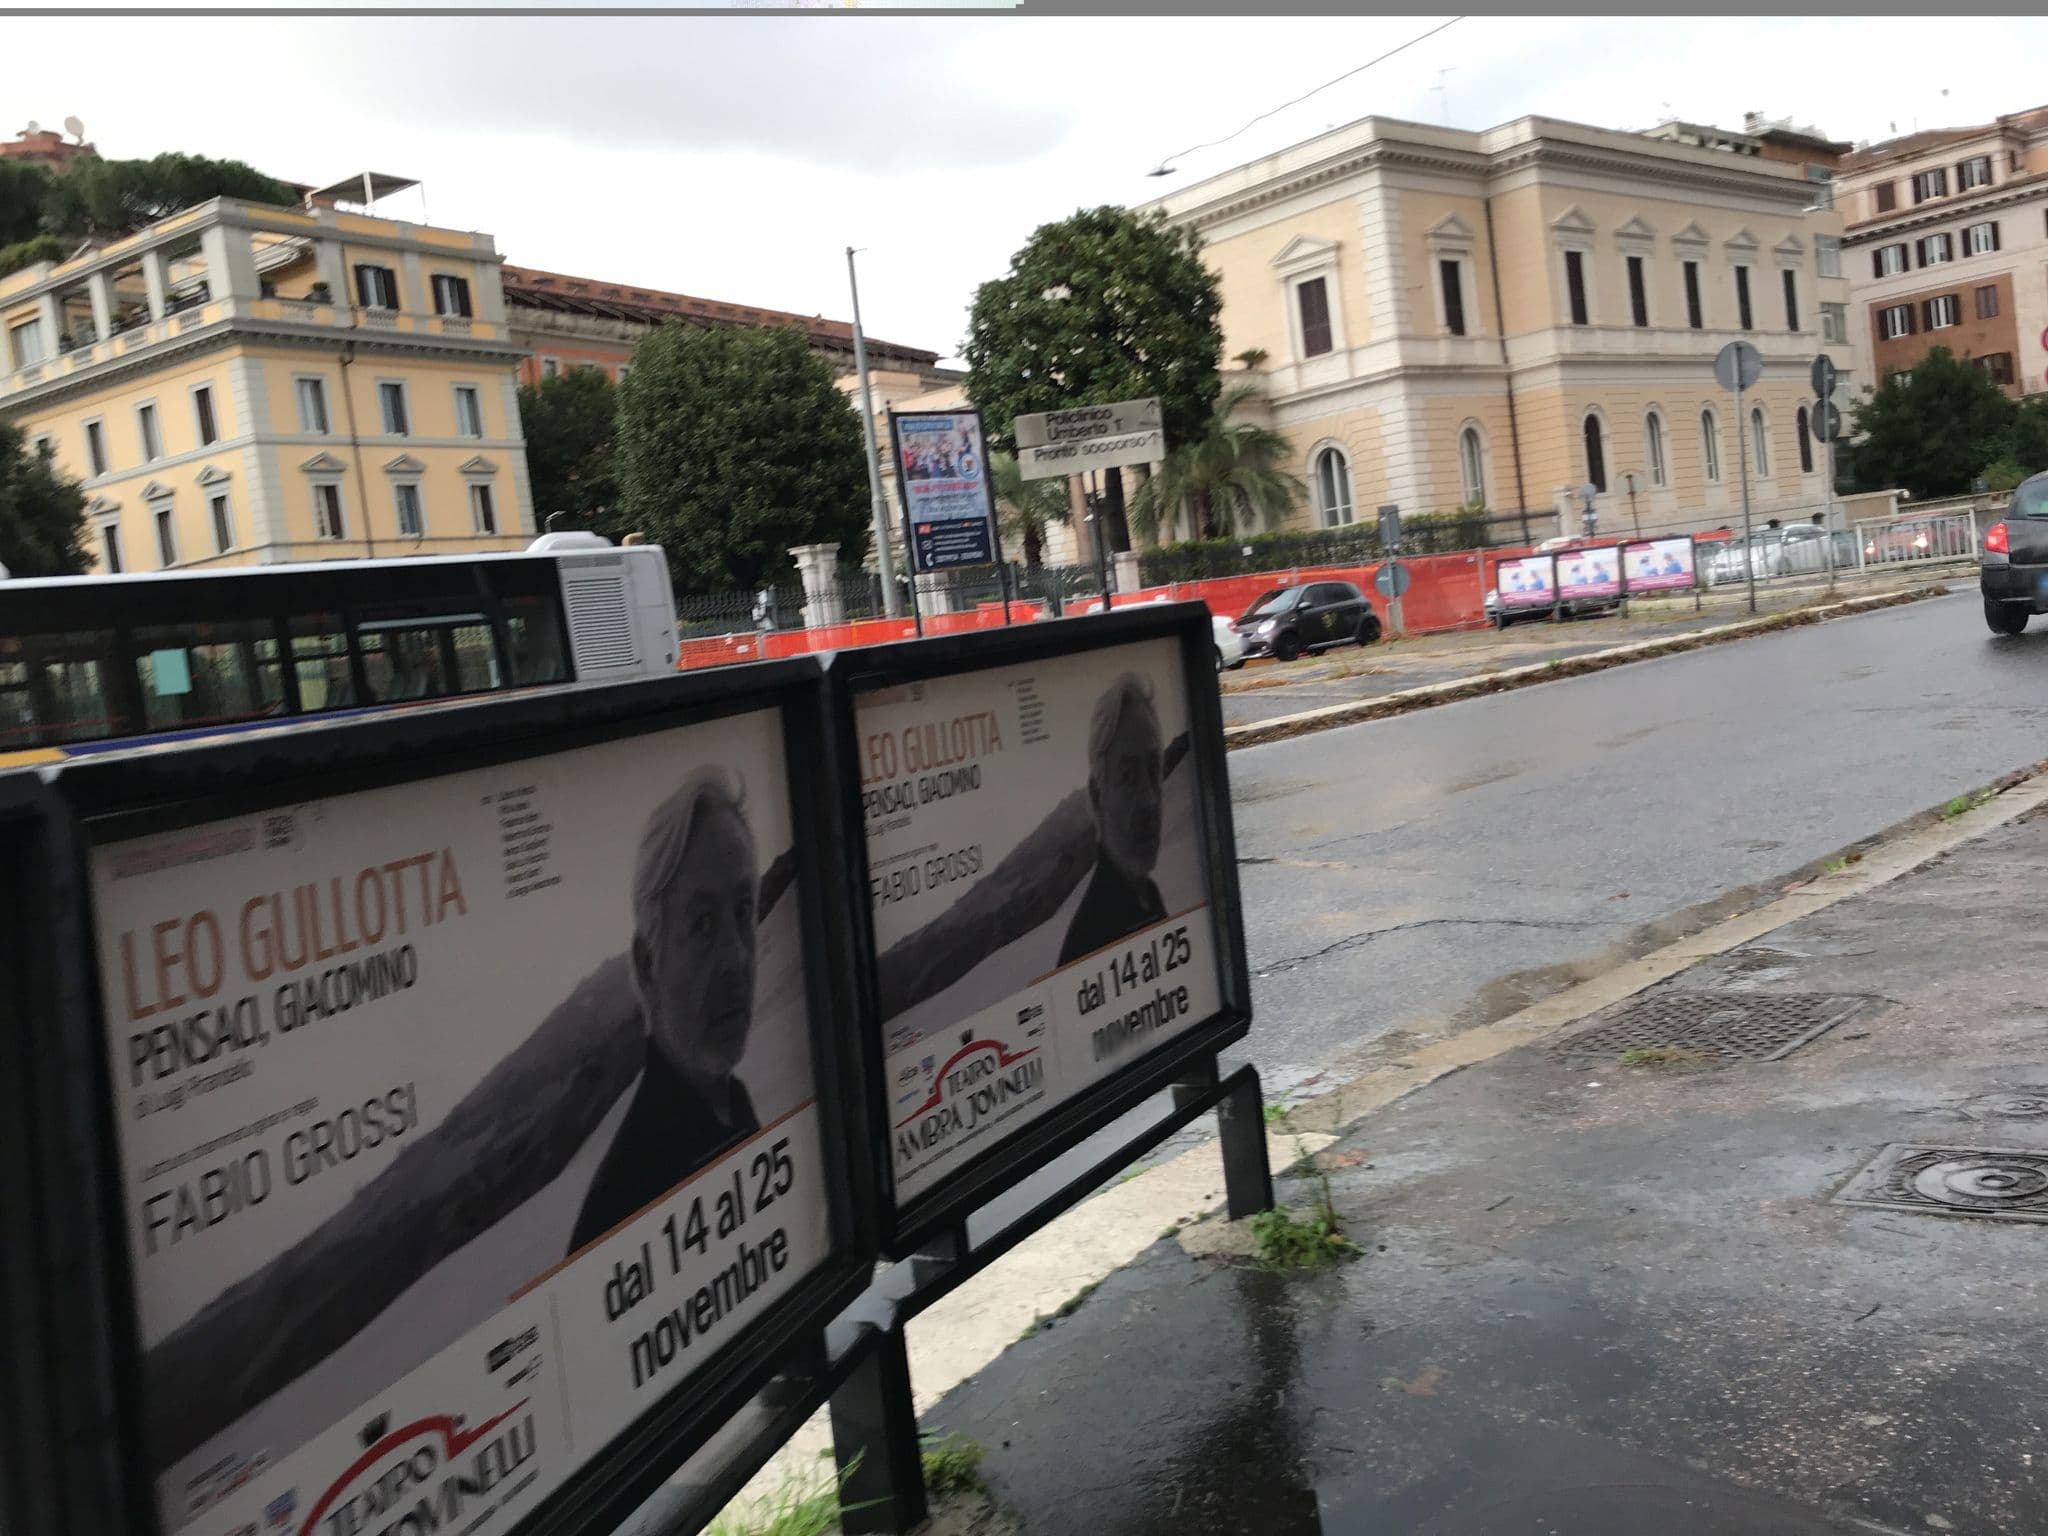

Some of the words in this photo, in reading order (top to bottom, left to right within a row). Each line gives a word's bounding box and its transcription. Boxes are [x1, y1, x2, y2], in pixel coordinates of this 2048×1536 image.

[1034, 444, 1078, 462] Pronto
[1082, 436, 1146, 456] soccorso
[1046, 408, 1113, 427] Policlinico
[1047, 422, 1107, 441] Umberto
[902, 710, 1002, 774] GULLOTTA
[918, 763, 981, 805] GIACOMINO
[924, 844, 985, 890] GROSSI
[119, 909, 226, 1023] LEO
[239, 847, 467, 982] GULLOTTA
[1077, 971, 1106, 1016] dal
[1109, 951, 1138, 998] 14
[1140, 939, 1160, 984] al
[1162, 925, 1191, 972] 25
[275, 943, 419, 1034] GIACOMINO
[1092, 985, 1190, 1062] novembre
[896, 1107, 963, 1166] AMBRA
[966, 1056, 1045, 1130] JOVINELLI
[946, 1053, 995, 1096] TEATRO
[141, 1148, 273, 1257] FABIO
[282, 1081, 419, 1186] GROSSI
[605, 1242, 655, 1323] dal
[662, 1195, 711, 1276] 14
[714, 1168, 747, 1240] al
[751, 1136, 794, 1214] 25
[629, 1226, 789, 1389] novembre
